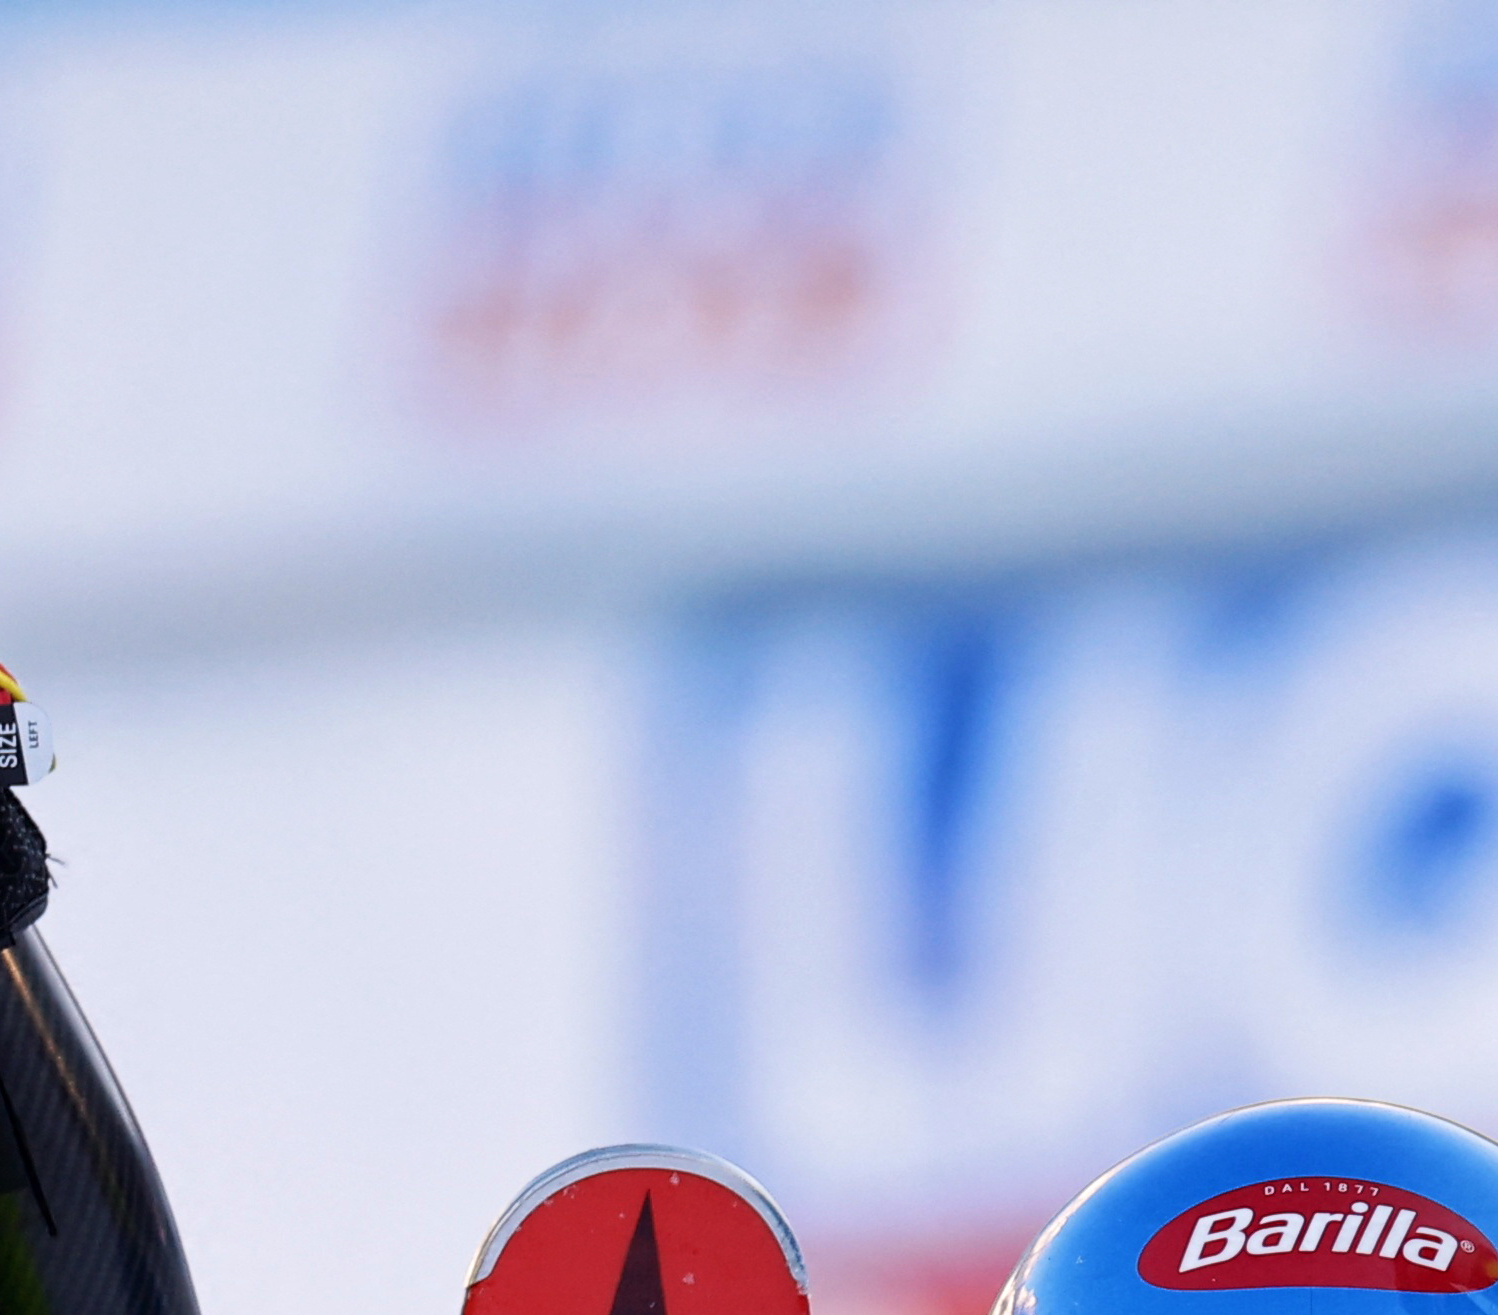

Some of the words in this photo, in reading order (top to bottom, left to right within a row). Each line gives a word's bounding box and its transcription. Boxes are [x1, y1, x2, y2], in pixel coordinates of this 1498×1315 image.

[29, 721, 38, 749] LEFT
[1264, 1182, 1310, 1196] DAL
[1323, 1182, 1380, 1197] 1877
[1177, 1201, 1459, 1275] Barilla
